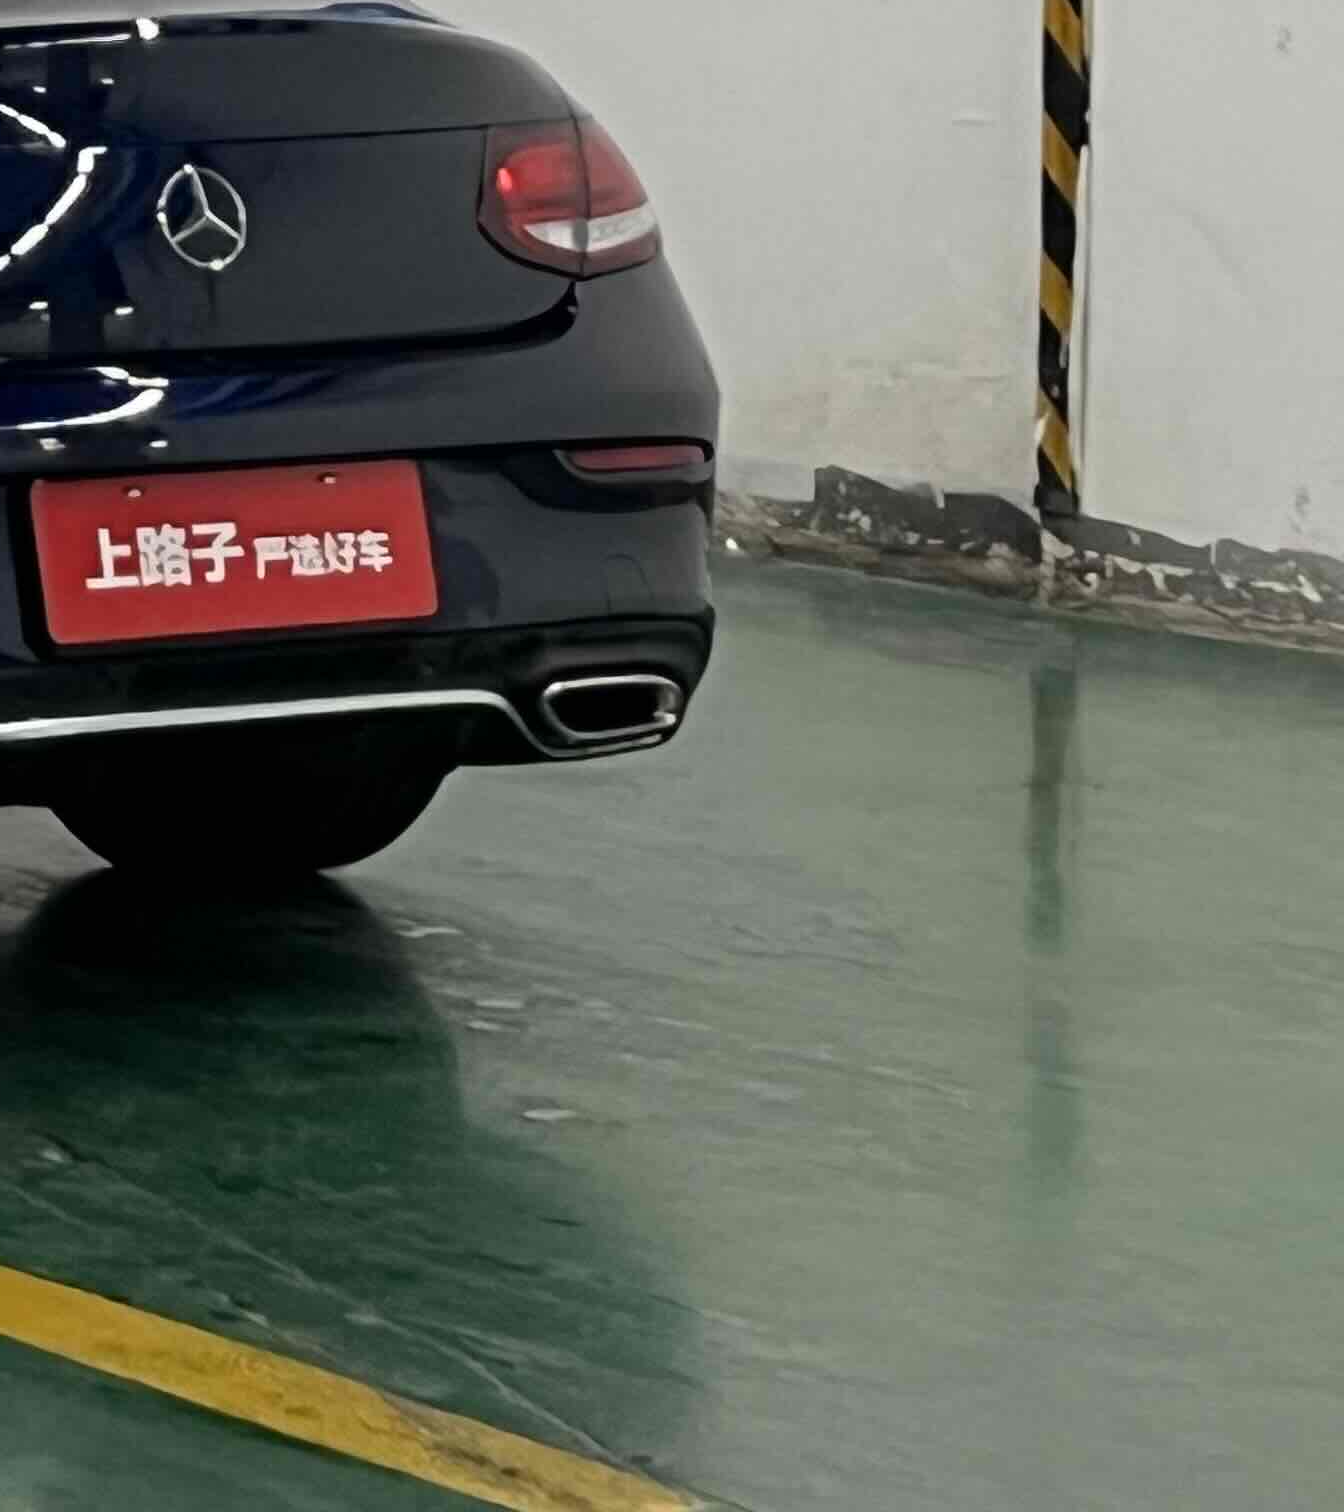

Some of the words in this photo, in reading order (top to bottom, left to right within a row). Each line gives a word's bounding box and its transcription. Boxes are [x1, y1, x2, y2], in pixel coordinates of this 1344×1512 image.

[85, 521, 246, 590] 上路子
[252, 529, 394, 580] 严选好车
